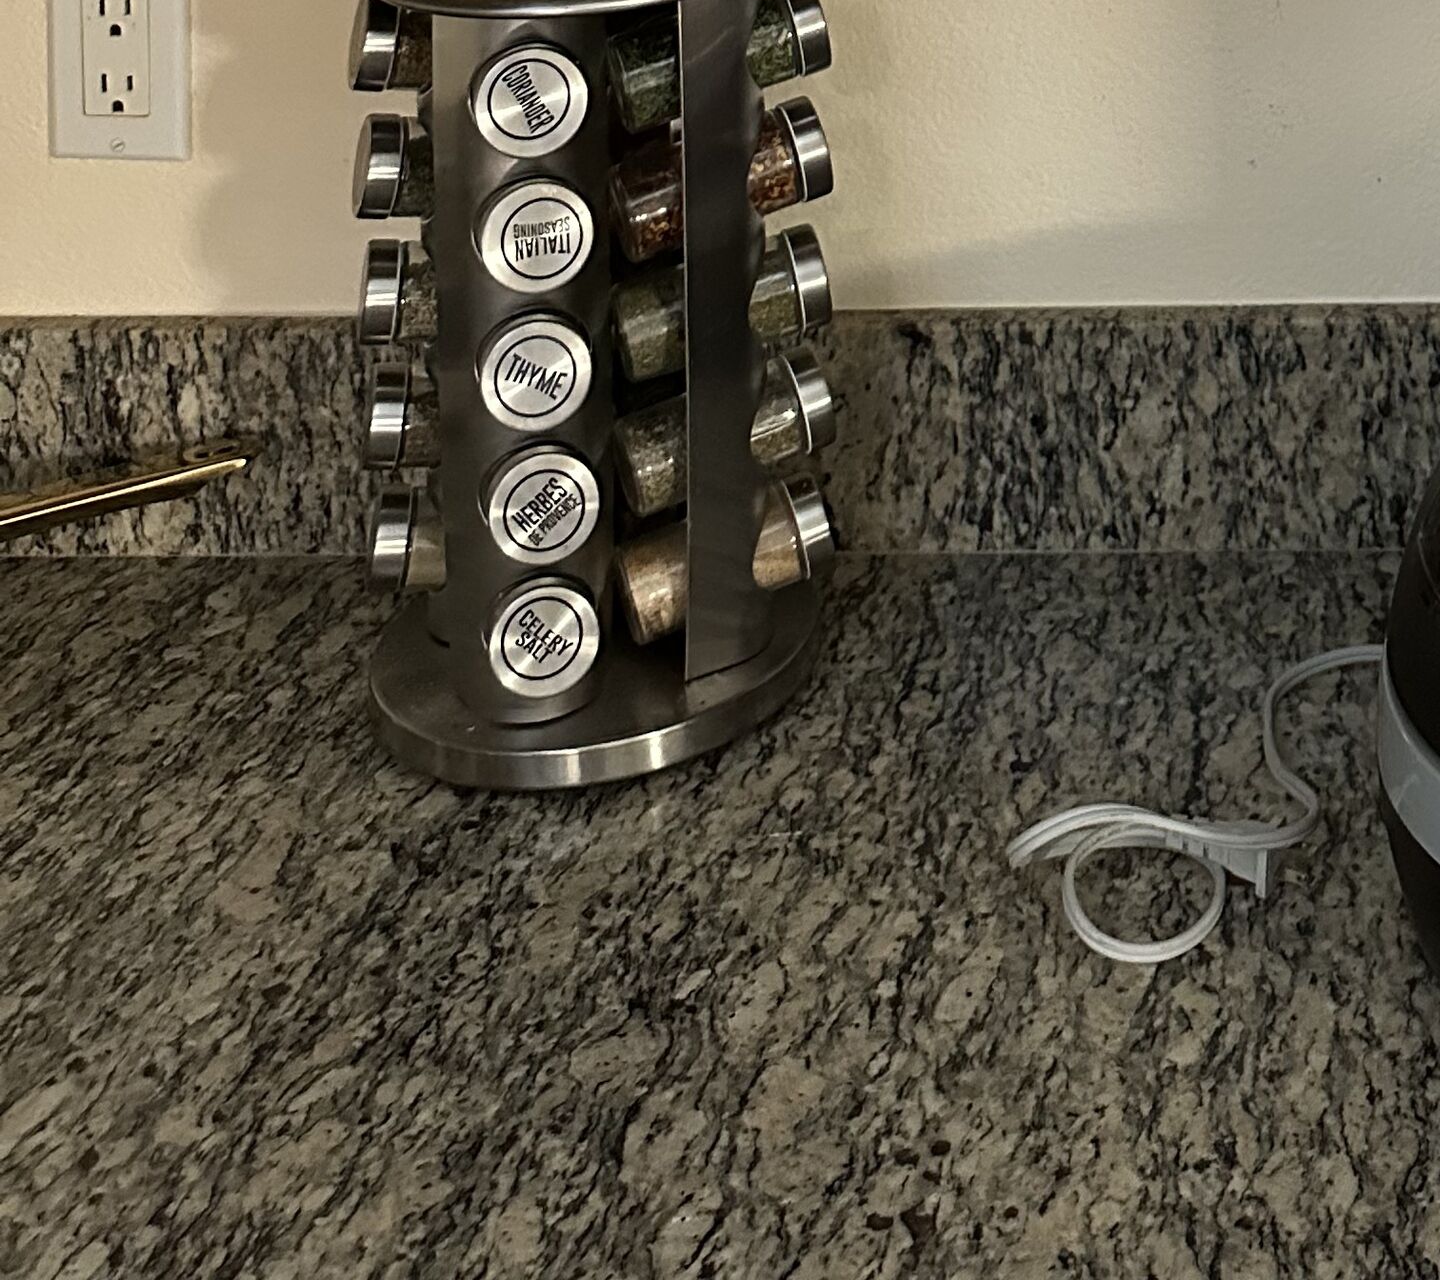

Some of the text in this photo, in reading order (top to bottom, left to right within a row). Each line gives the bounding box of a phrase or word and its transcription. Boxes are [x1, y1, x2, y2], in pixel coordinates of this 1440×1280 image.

[501, 64, 555, 134] CORIANDER
[513, 216, 571, 239] SEASONING
[514, 232, 571, 262] ITALIAN
[504, 352, 568, 401] THYME
[511, 477, 568, 533] HERBES
[528, 493, 582, 547] DE PROVENCE
[515, 630, 553, 664] SALT
[519, 609, 574, 656] CELERY
